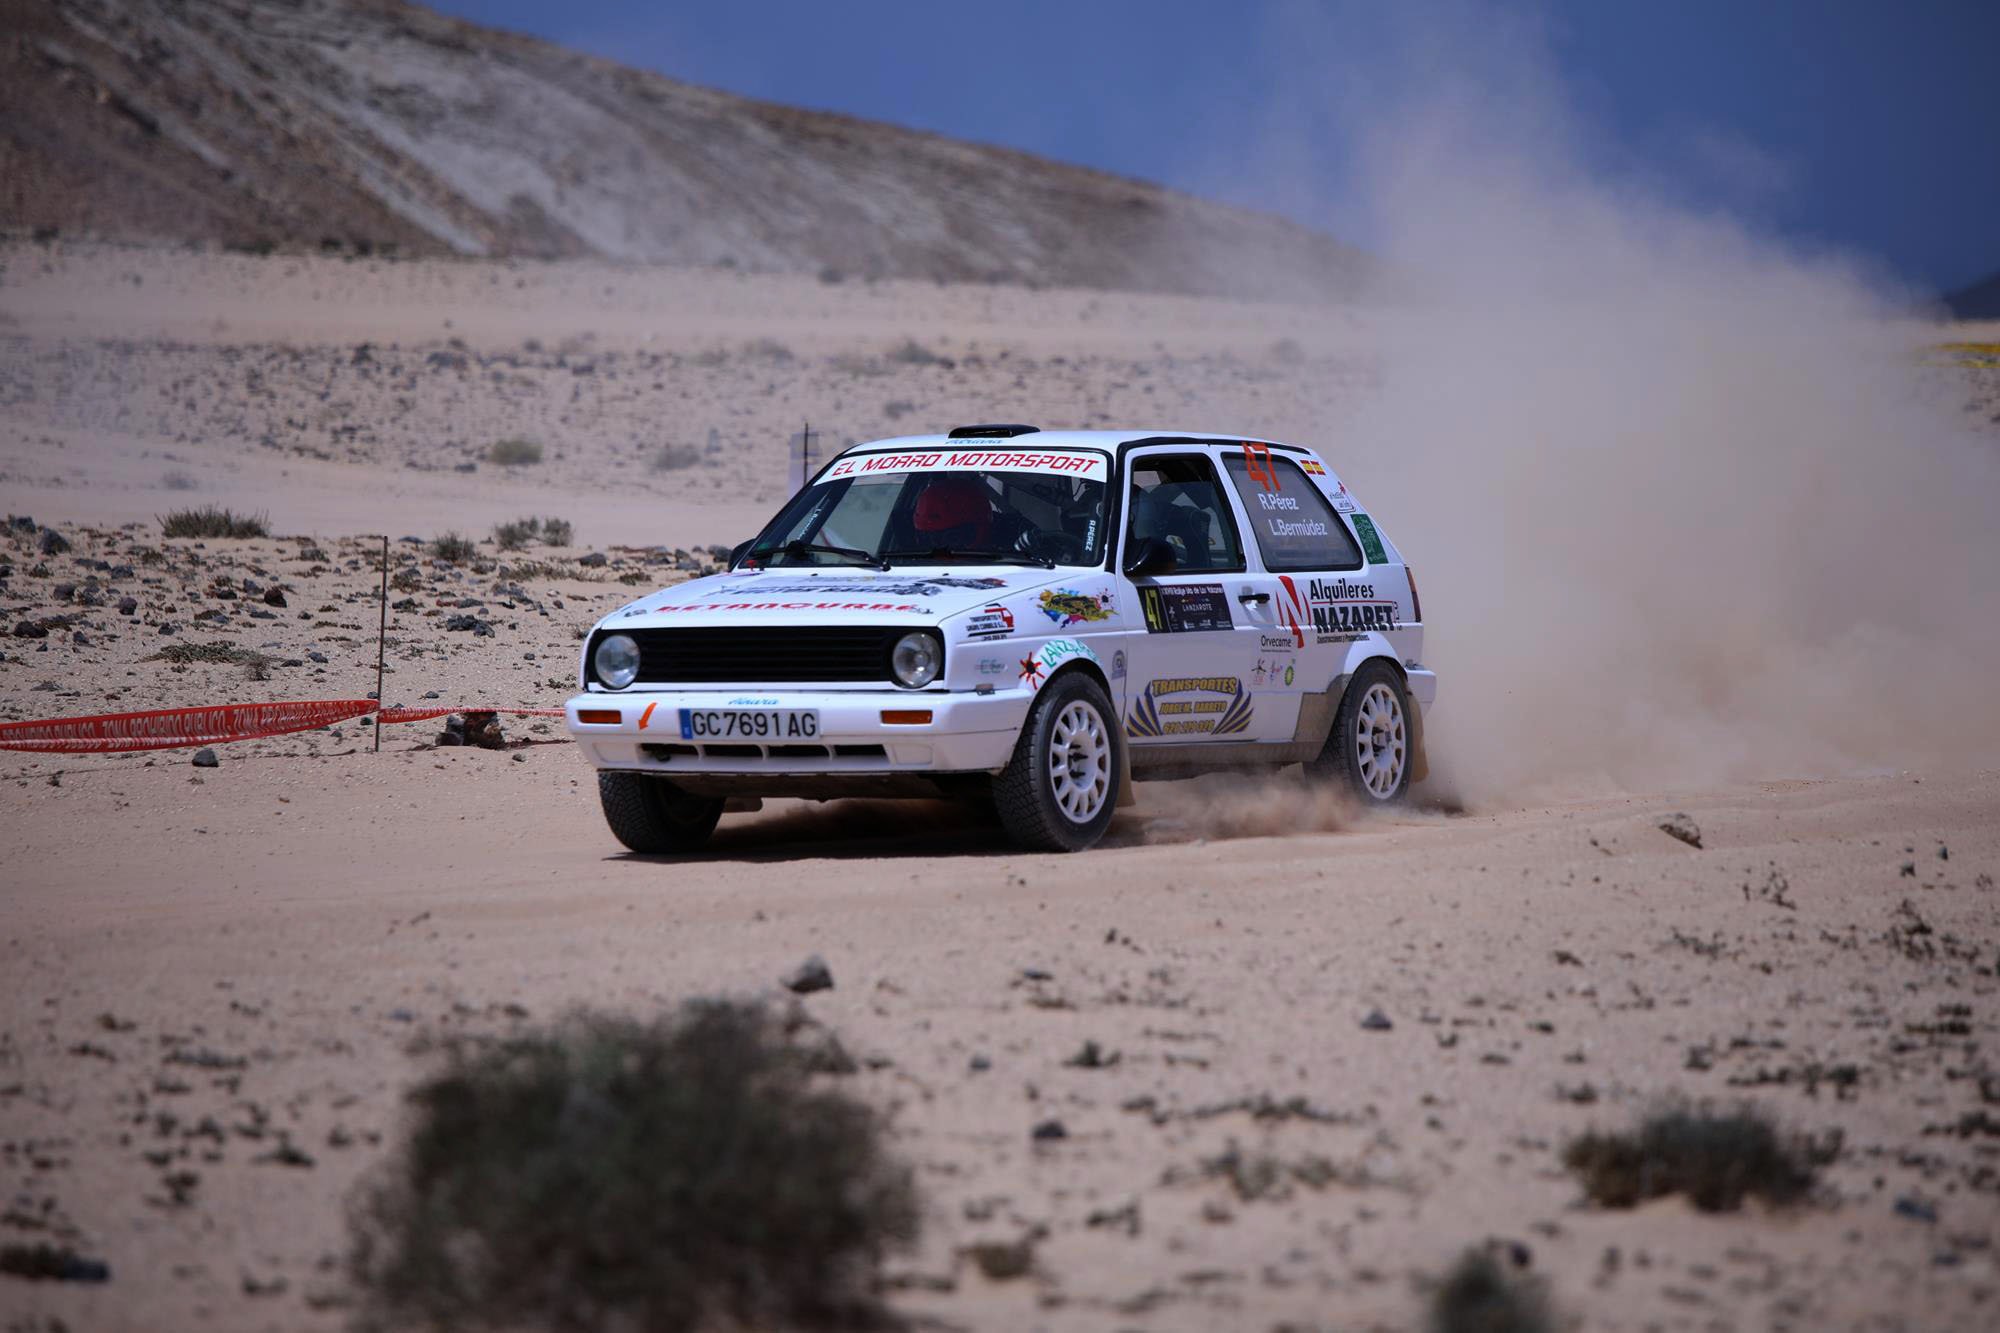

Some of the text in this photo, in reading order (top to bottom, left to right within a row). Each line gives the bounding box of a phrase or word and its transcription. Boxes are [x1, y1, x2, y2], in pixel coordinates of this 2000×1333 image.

[831, 453, 1100, 476] EL MORRO MOTORSPORT
[1242, 442, 1281, 491] 47
[1258, 493, 1300, 510] R.Pérez
[1268, 518, 1328, 536] L.Bermúdez
[1310, 578, 1374, 605] Alquileres
[1312, 605, 1395, 634] NAZARET
[1261, 635, 1292, 648] Orvecame
[1152, 677, 1237, 697] TRANSPORTES
